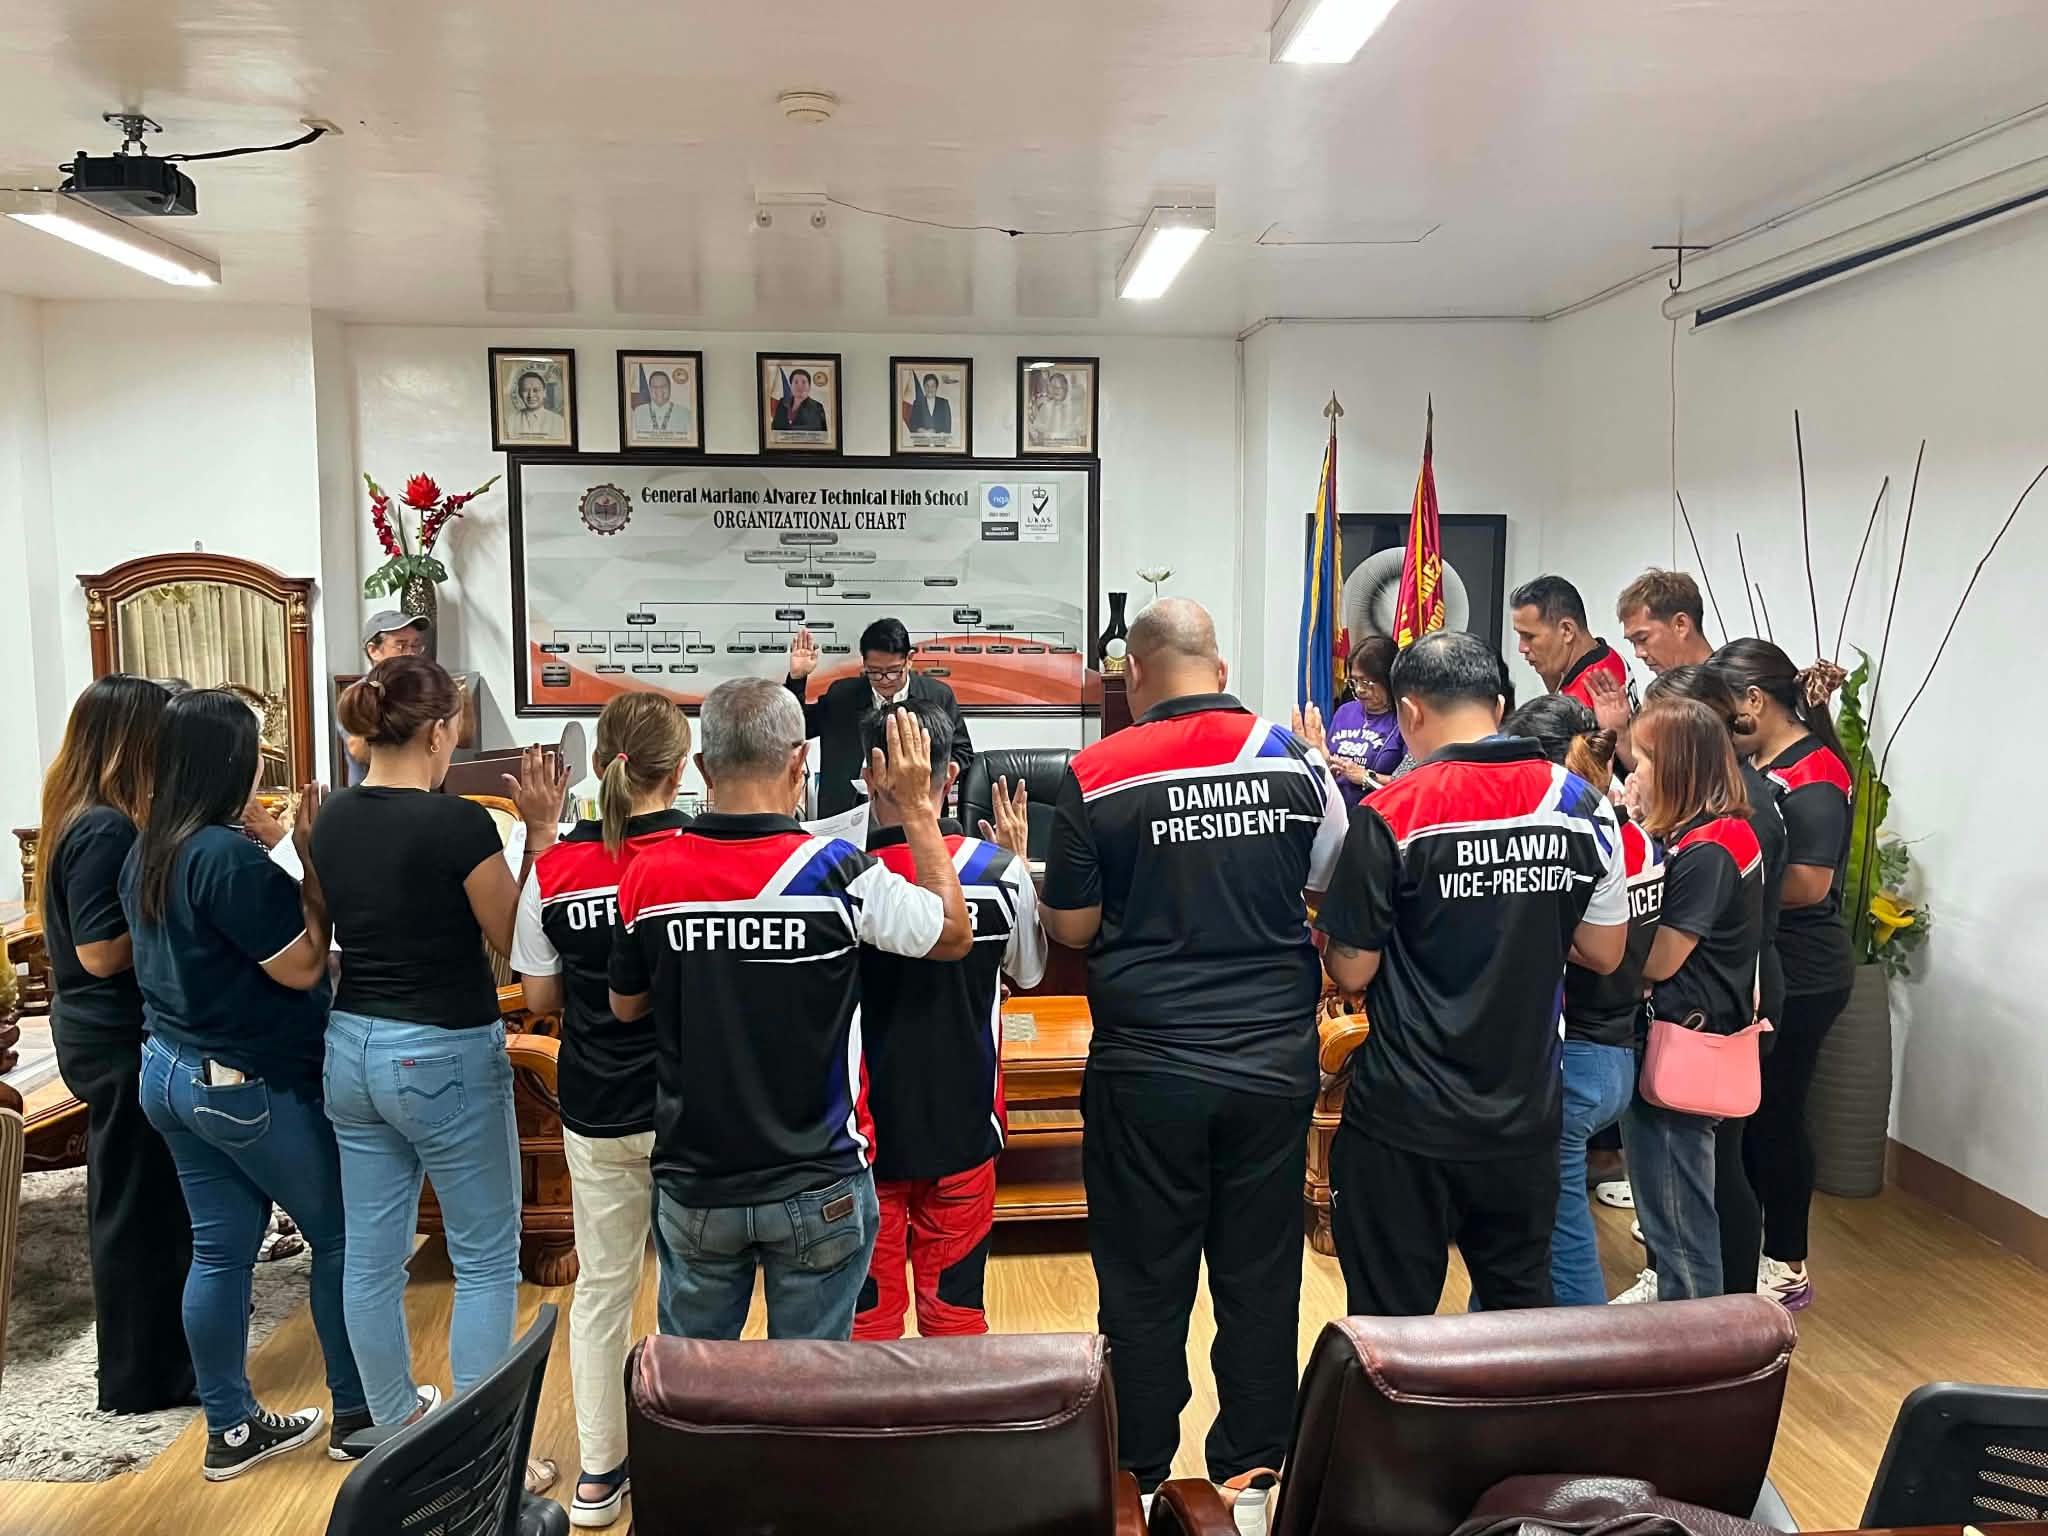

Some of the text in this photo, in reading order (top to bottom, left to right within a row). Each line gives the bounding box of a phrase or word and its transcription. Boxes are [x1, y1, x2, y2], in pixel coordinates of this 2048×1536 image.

[641, 487, 969, 506] General Mariano Alvarez Technical High School
[713, 510, 907, 530] ORGANIZATIONAL CHART
[1167, 778, 1270, 812] DAMIAN
[1151, 808, 1290, 845] PRESIDENT
[666, 917, 807, 951] OFFICER
